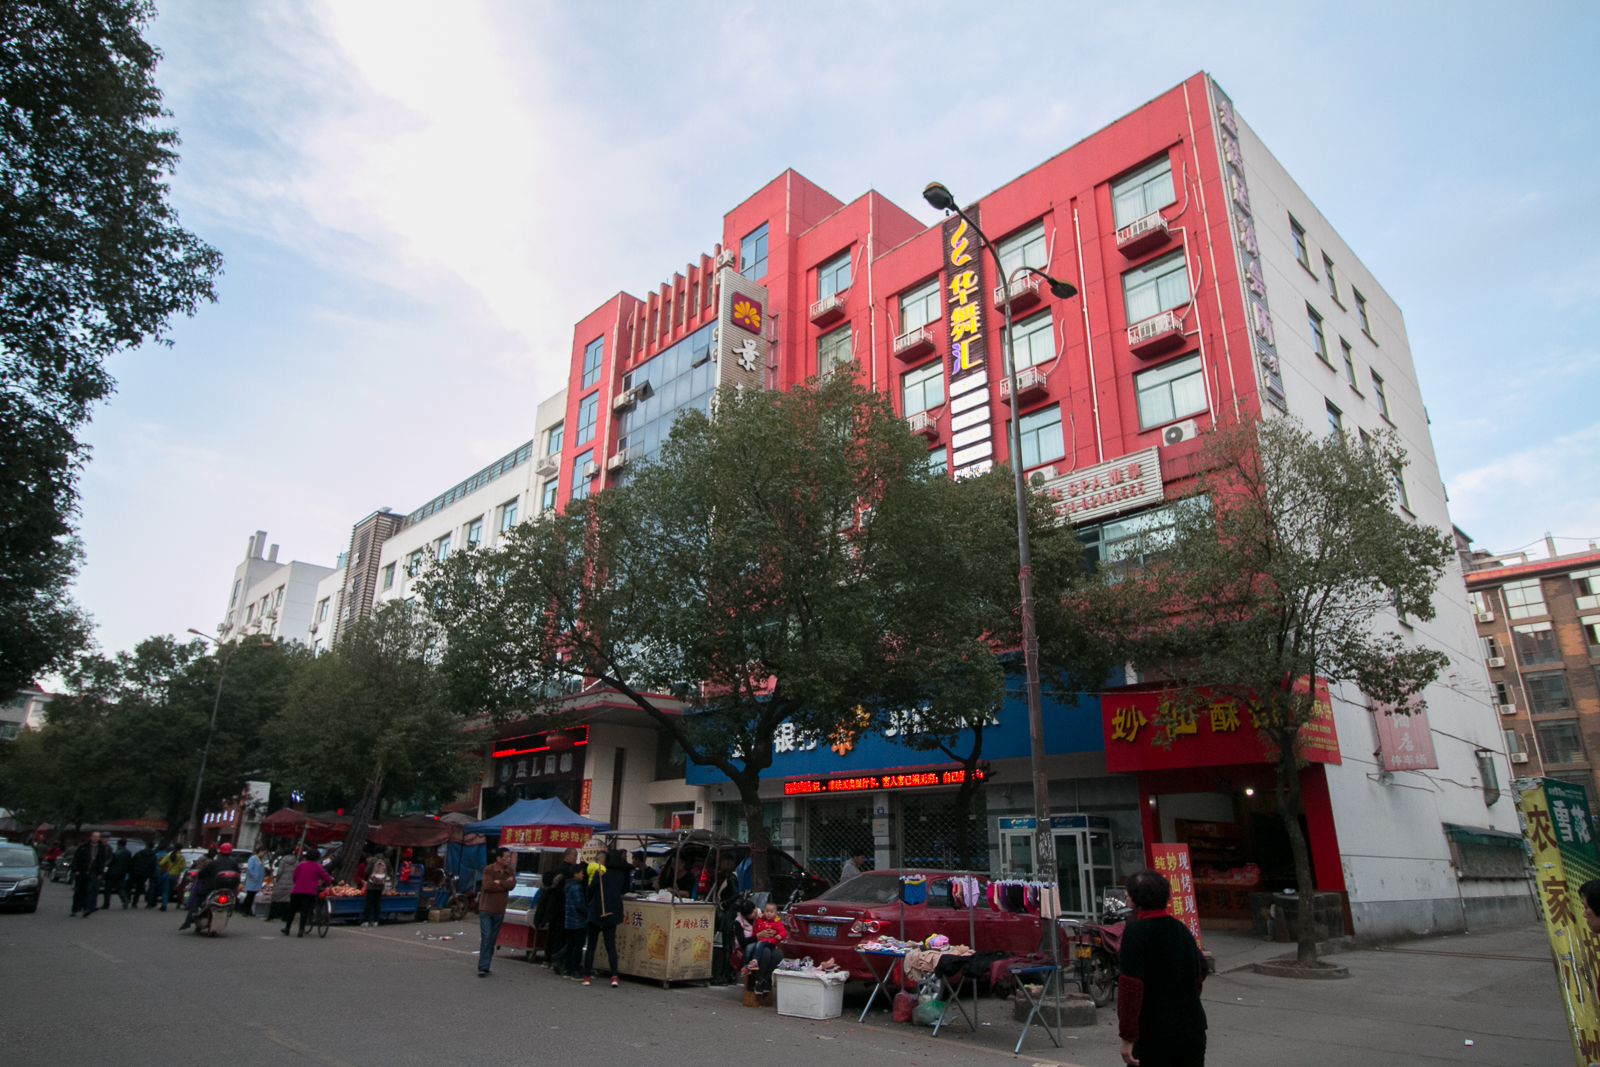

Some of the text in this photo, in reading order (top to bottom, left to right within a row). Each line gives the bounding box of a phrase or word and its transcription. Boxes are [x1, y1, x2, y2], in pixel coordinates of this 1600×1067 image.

[1034, 463, 1142, 500] 生SPA推拿
[1390, 754, 1428, 766] 停车场
[1177, 852, 1199, 938] 现烤现卖
